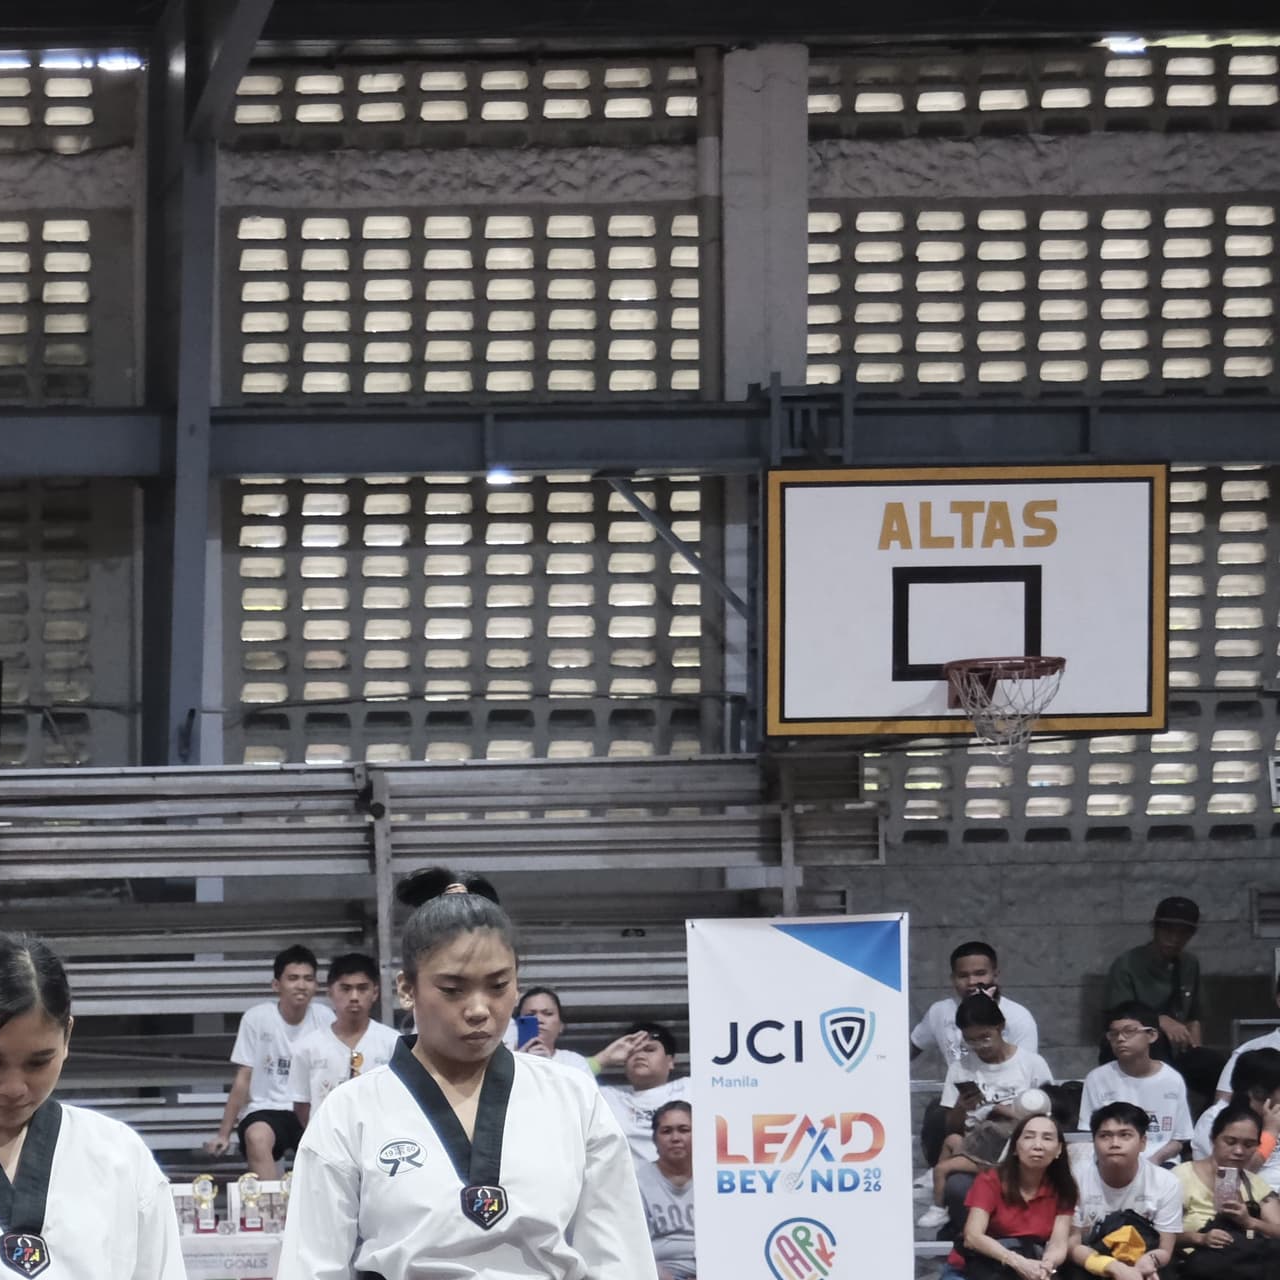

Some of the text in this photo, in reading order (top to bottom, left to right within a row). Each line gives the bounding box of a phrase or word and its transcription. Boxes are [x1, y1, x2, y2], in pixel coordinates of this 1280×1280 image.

[878, 499, 1059, 550] ALTAS
[711, 1019, 804, 1066] JCI
[711, 1076, 759, 1088] Manila
[715, 1112, 886, 1165] LEAD
[863, 1168, 882, 1180] 20
[863, 1181, 882, 1193] 26
[472, 1198, 499, 1212] PTA
[12, 1248, 41, 1262] PTA
[224, 1258, 268, 1270] GOALS
